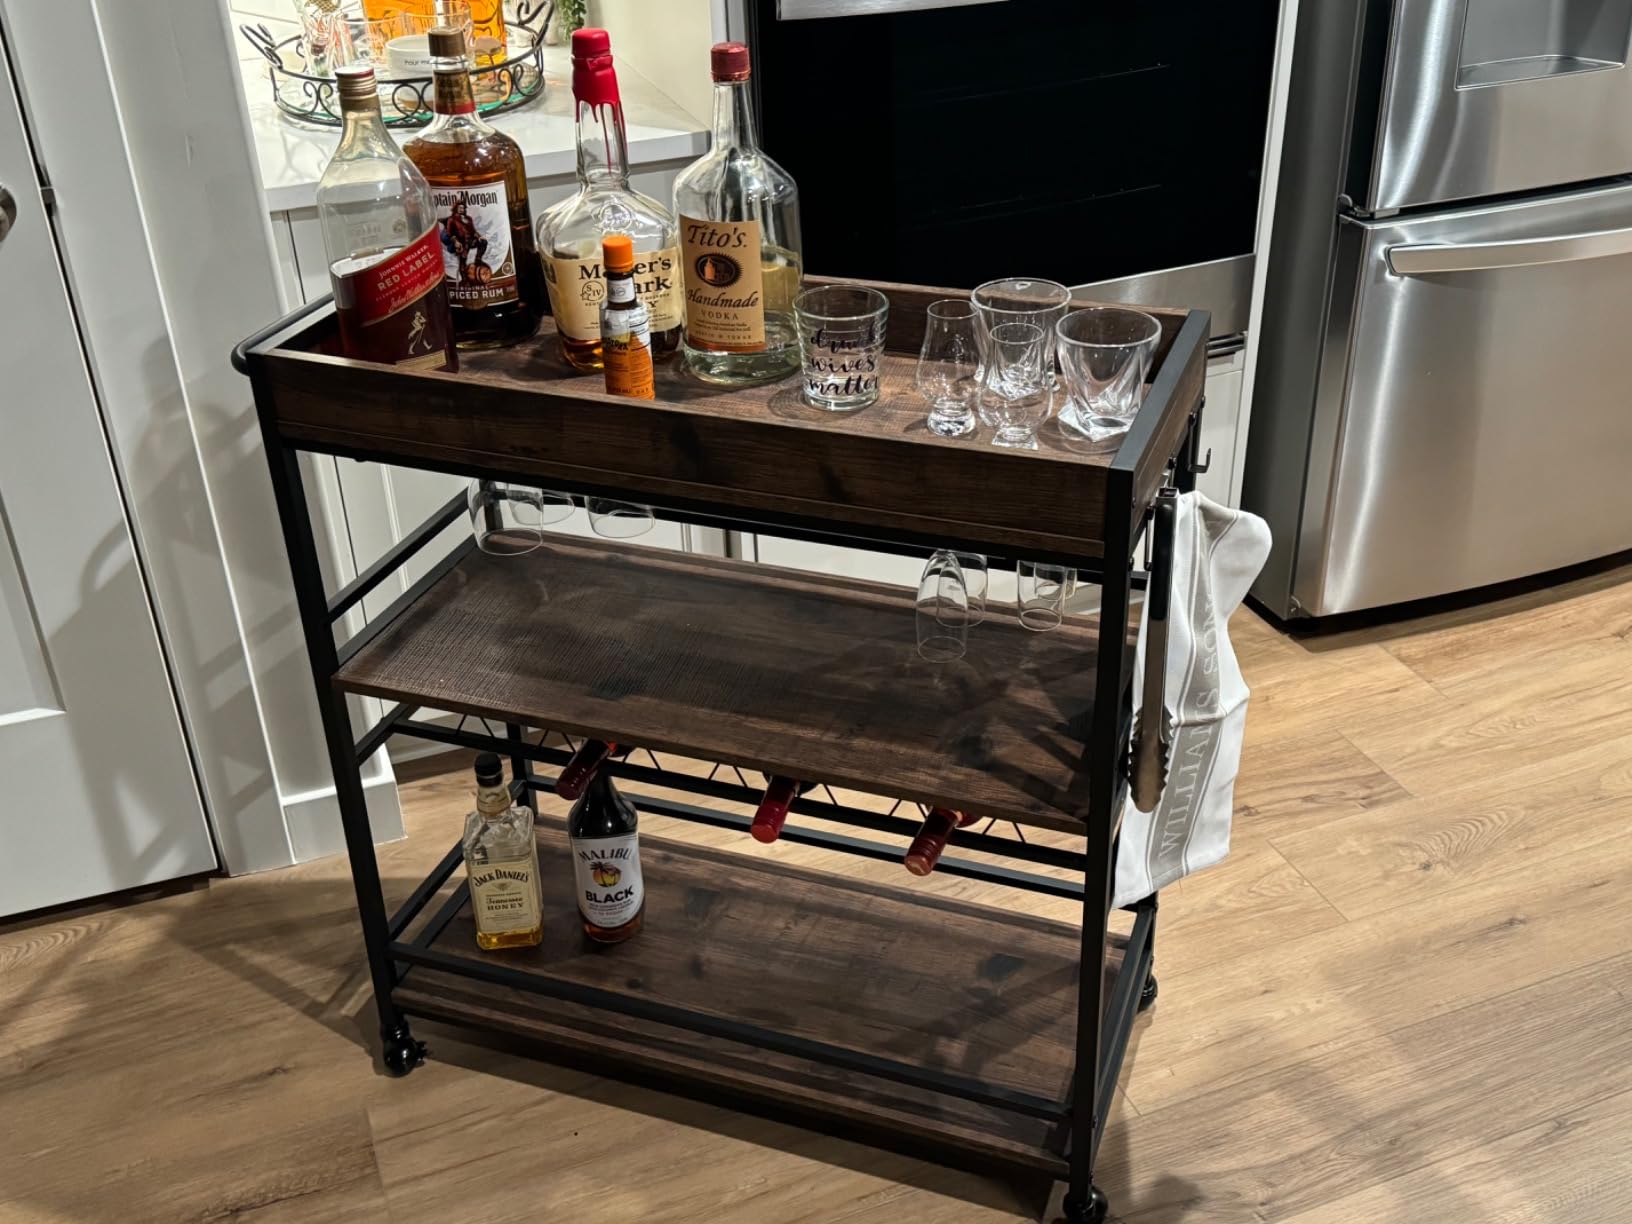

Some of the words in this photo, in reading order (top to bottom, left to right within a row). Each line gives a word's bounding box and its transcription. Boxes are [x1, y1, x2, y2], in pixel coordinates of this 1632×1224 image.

[433, 190, 457, 208] ptain
[458, 190, 498, 207] Morgan
[687, 224, 747, 248] Tito's
[377, 274, 400, 291] RED
[402, 251, 436, 277] LABEL
[578, 257, 671, 280] Mer's
[449, 290, 478, 299] PICED
[482, 288, 504, 298] RUM
[634, 276, 672, 294] ark
[687, 288, 759, 308] Handmade
[701, 309, 739, 320] VODKA
[810, 354, 876, 372] wives
[1203, 592, 1218, 675] SON
[579, 848, 632, 863] MALIBU
[473, 872, 496, 887] JACK
[585, 885, 634, 903] BLACK
[487, 902, 523, 911] HONEY
